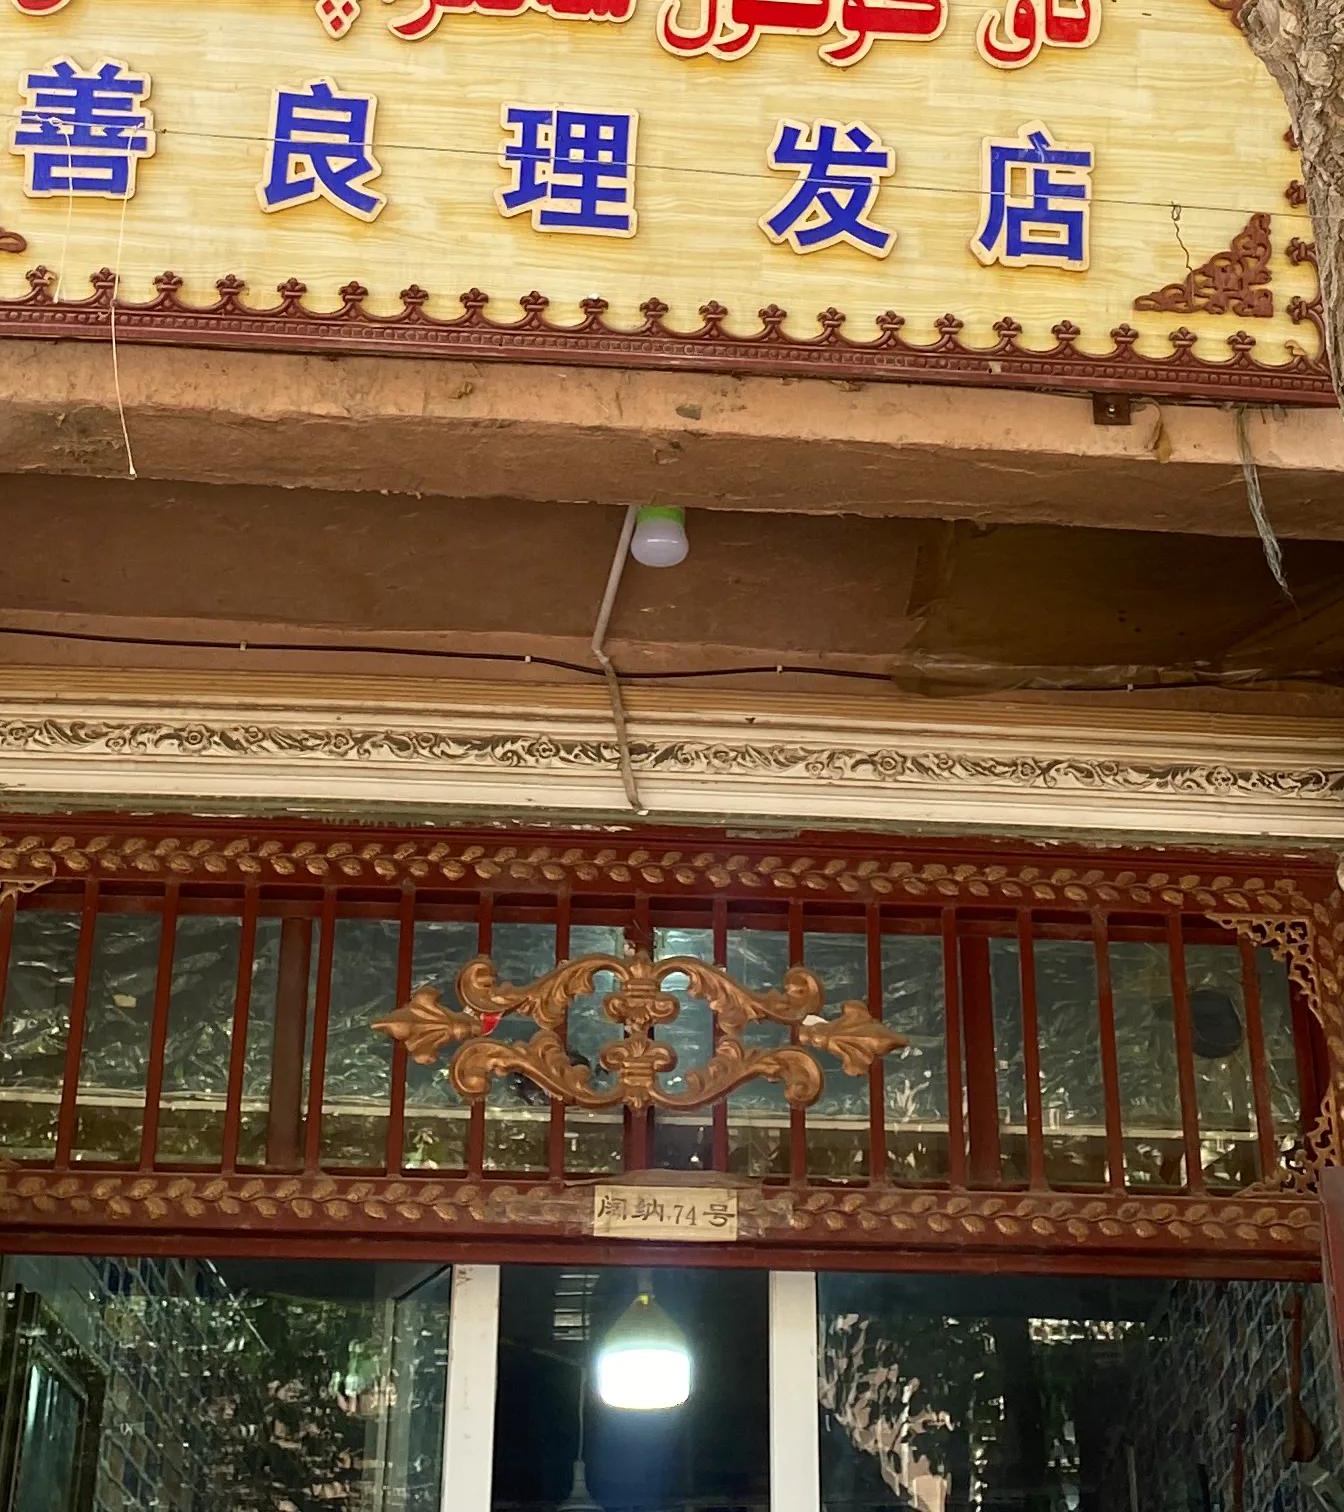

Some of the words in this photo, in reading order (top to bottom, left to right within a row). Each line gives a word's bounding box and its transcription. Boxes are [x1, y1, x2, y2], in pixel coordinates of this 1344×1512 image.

[15, 61, 1092, 264] 善良理发店
